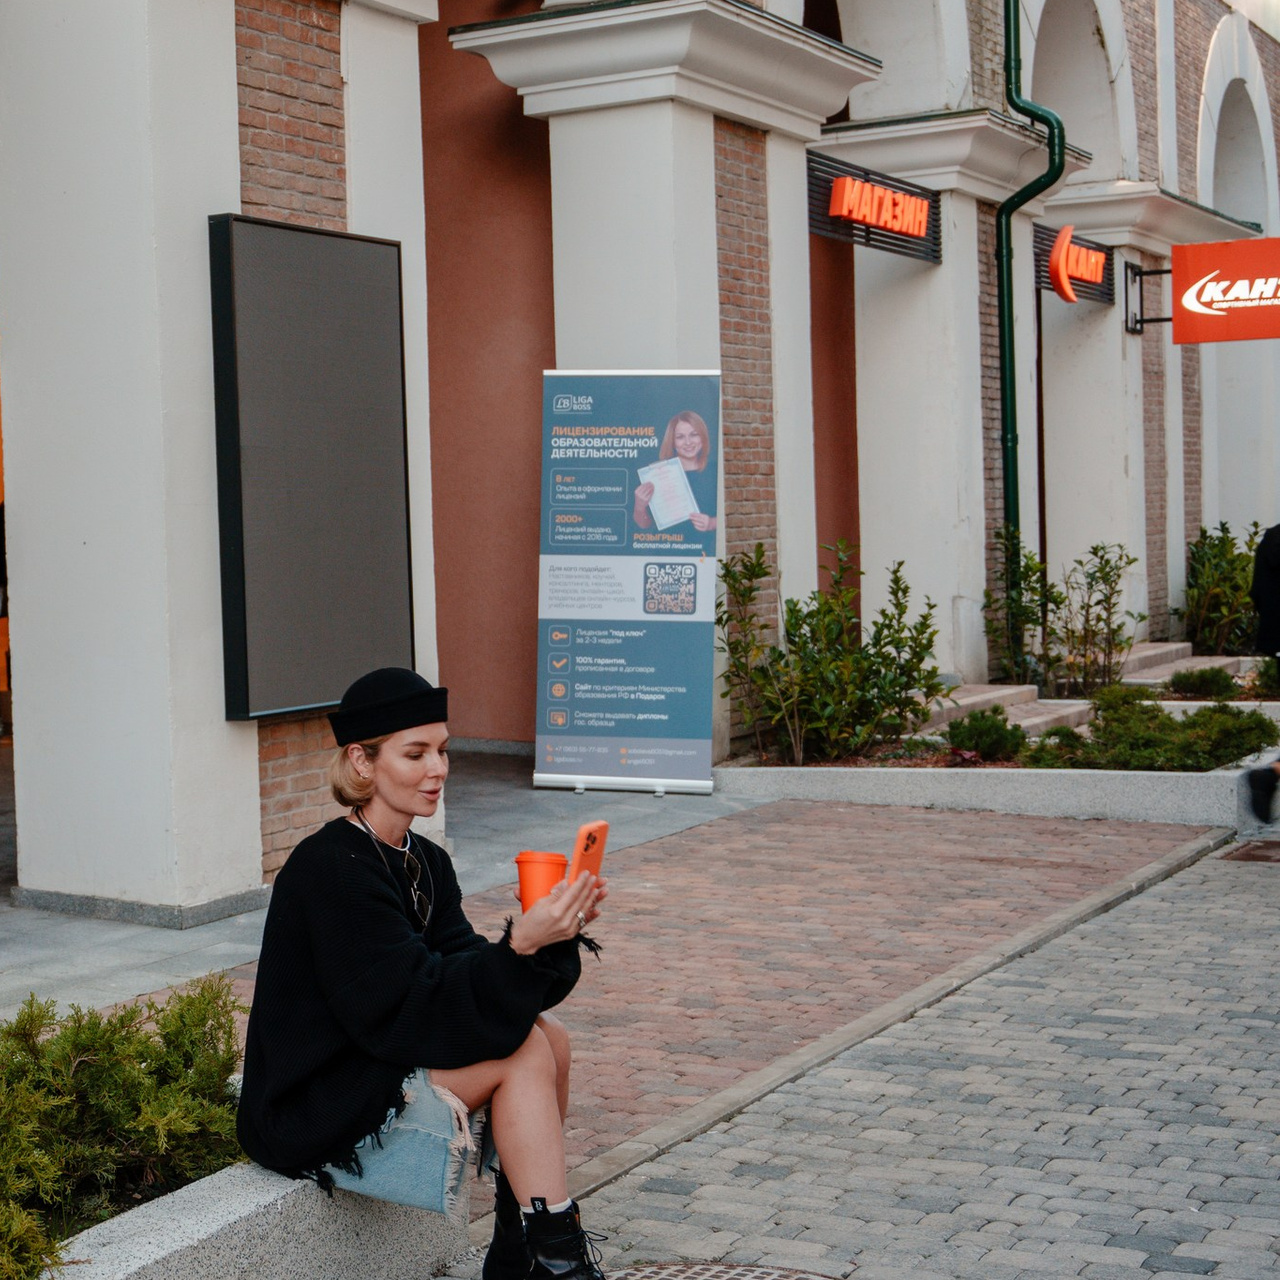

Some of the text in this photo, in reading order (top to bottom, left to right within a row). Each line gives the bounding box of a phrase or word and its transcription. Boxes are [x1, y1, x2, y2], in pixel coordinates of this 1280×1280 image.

[829, 176, 929, 237] МАГАЗИН
[1067, 243, 1105, 283] КАНТ
[1200, 277, 1280, 302] КАН
[552, 426, 655, 436] ЛИЦЕНЗИРОВАНИЕ
[551, 436, 658, 448] ОБРАЗОВАТЕЛЬНОЙ
[551, 448, 638, 459] ДЕЯТЕЛЬНОСТИ
[555, 515, 583, 523] 2000+
[633, 533, 683, 541] РОЗЫГРЫШ
[636, 693, 665, 701] Подарок
